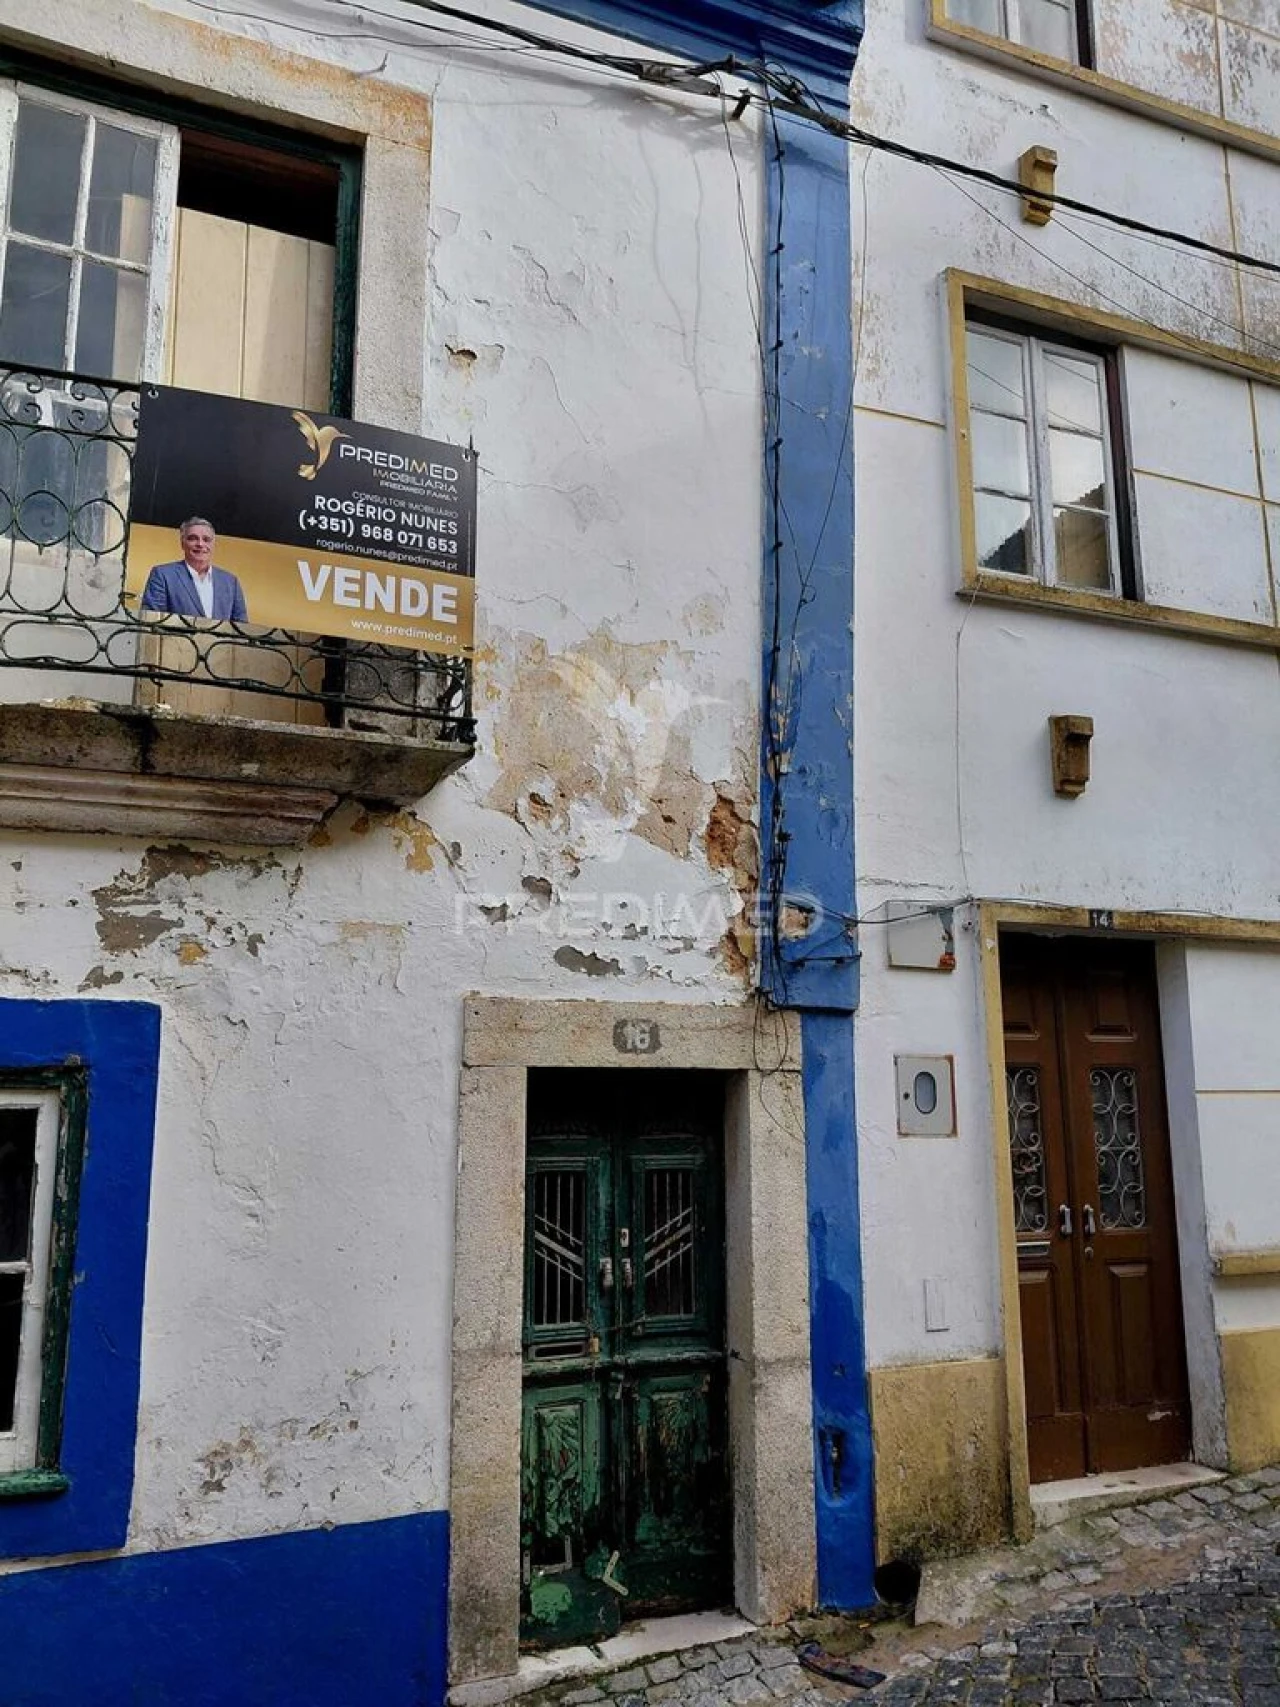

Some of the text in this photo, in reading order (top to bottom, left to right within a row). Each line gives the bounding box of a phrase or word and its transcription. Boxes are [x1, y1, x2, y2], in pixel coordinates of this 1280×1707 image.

[339, 444, 459, 482] PREDIMED
[314, 494, 458, 536] ROGÉRIO NUNES
[352, 491, 406, 508] CONSULTOR
[298, 509, 458, 555] (+351) 968 071 653
[315, 538, 458, 571] rogerio.nunes@predimed.pt
[297, 559, 458, 625] VENDE
[351, 619, 458, 646] www.predimed.pt
[1092, 911, 1109, 928] 14
[622, 1020, 651, 1050] 16
